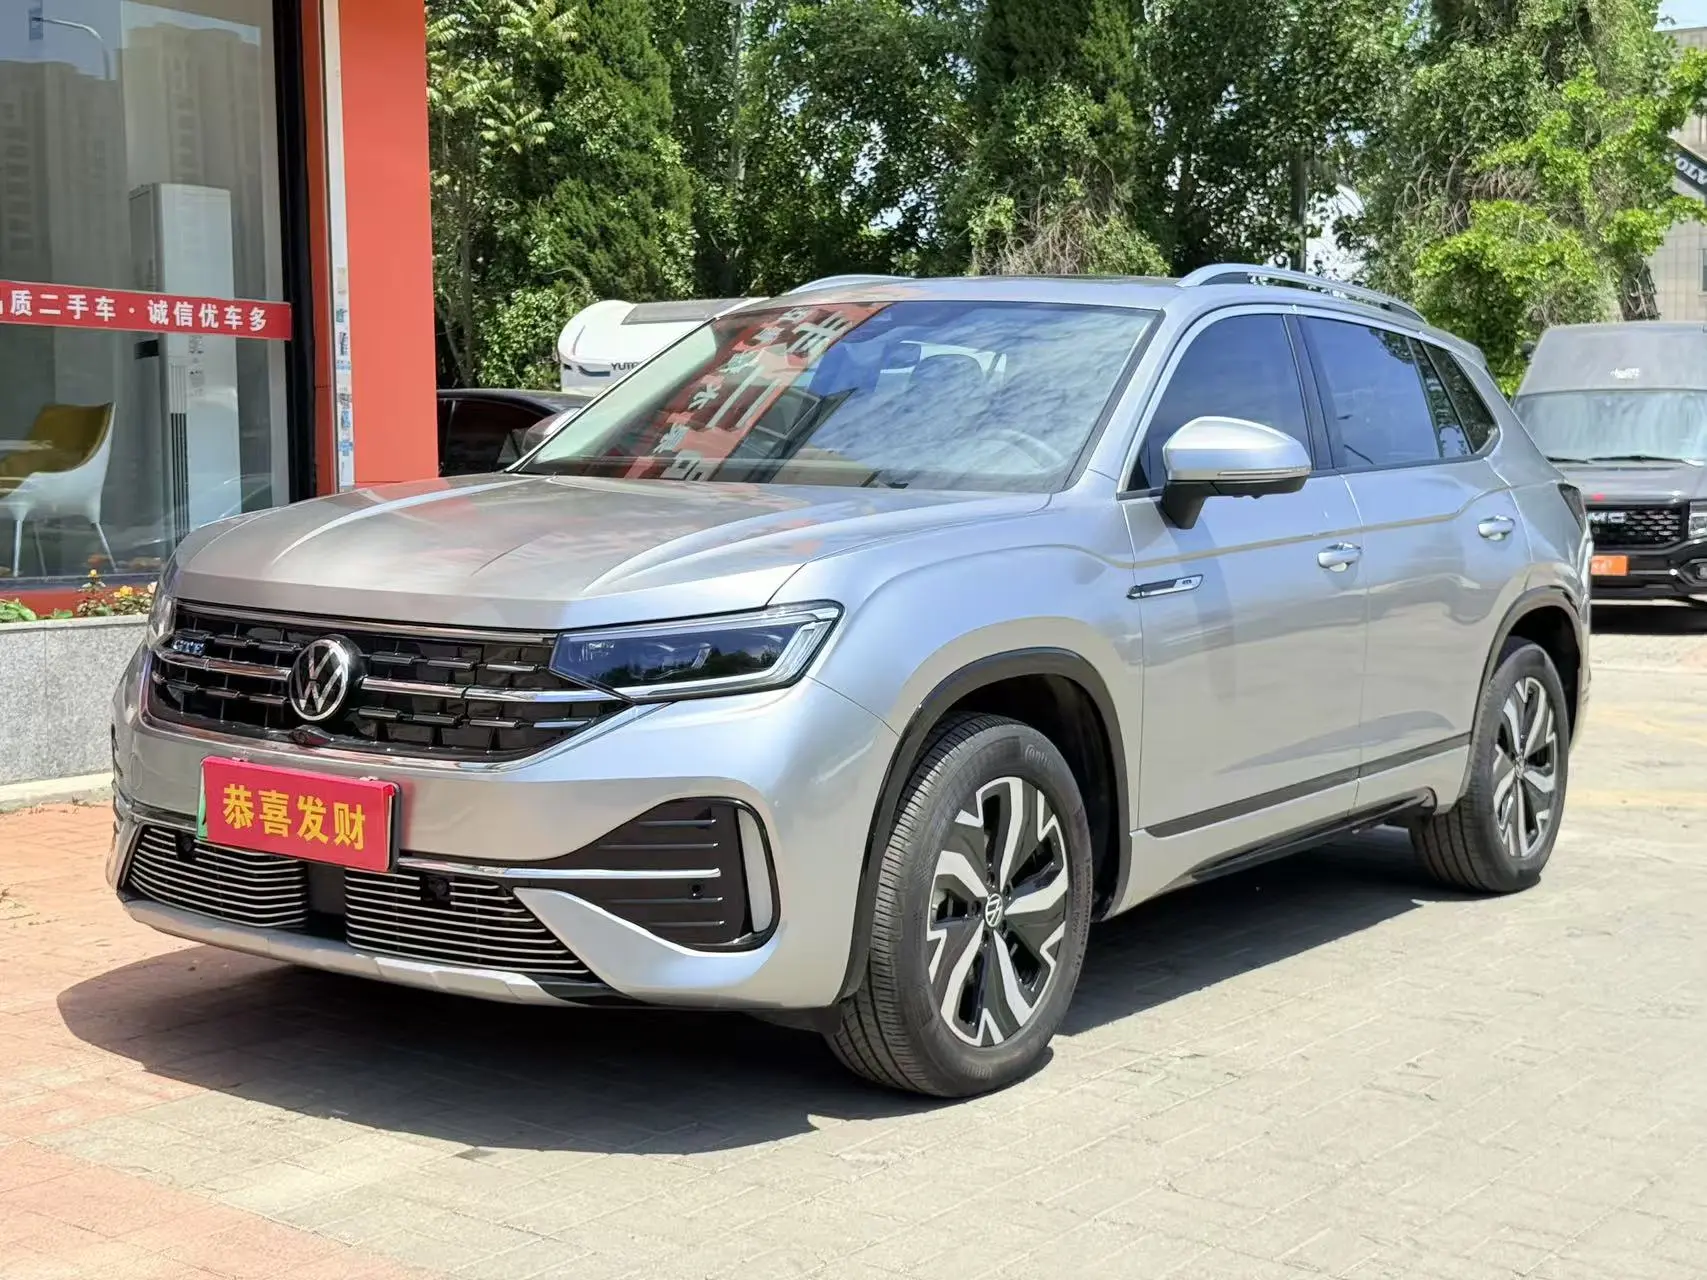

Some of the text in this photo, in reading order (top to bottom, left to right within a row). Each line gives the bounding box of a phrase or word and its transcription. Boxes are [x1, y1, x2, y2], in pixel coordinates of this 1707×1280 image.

[0, 289, 267, 331] 质二手车·诚信优车多
[222, 783, 366, 850] 恭喜发财
